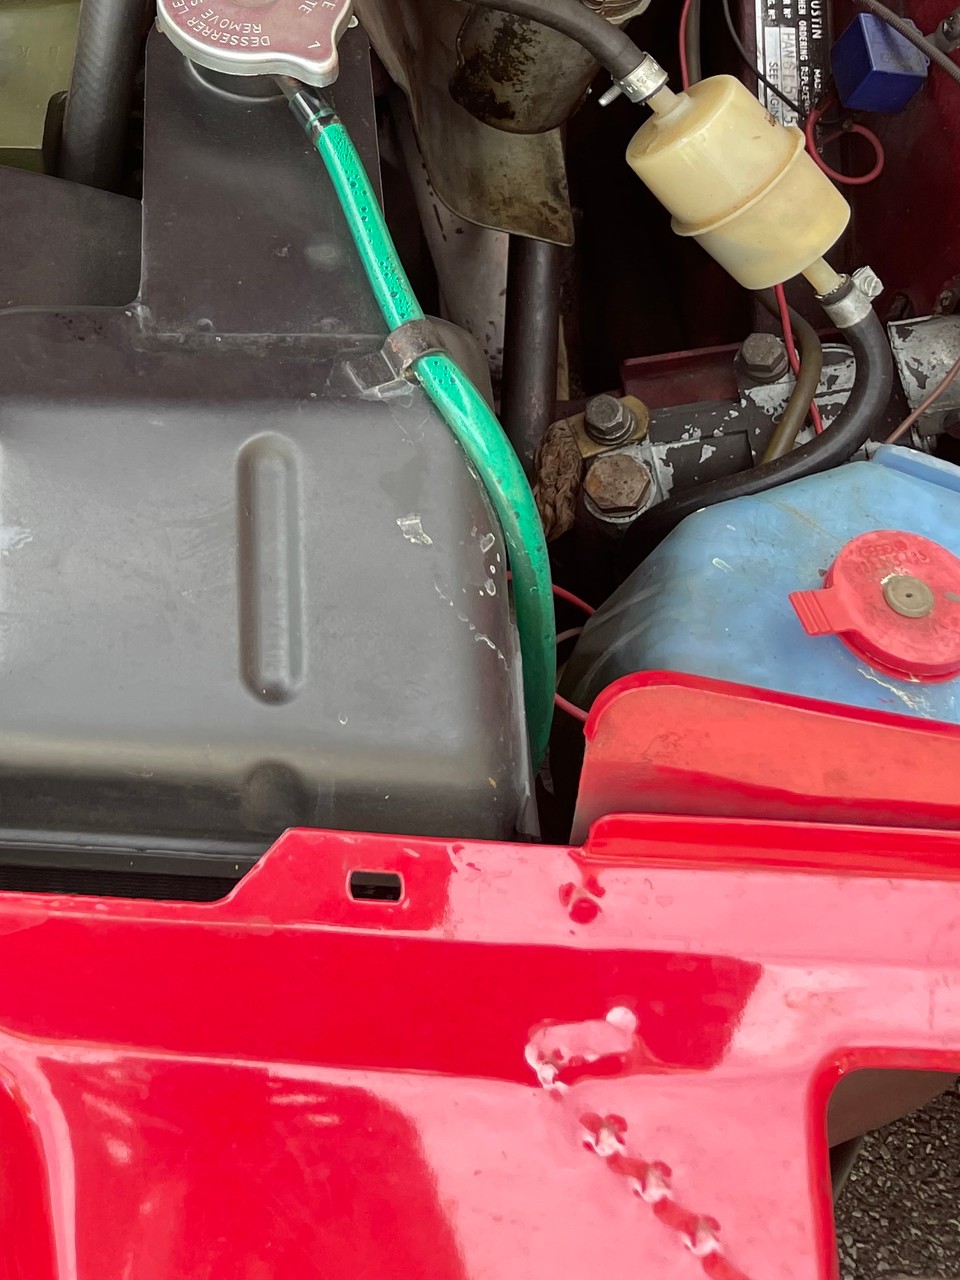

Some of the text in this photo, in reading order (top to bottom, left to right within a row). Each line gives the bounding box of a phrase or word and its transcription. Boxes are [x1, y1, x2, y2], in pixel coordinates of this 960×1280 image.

[186, 16, 271, 47] DESSERRER
[201, 8, 262, 34] REMOVE
[798, 20, 808, 61] ORDERING
[769, 61, 778, 80] SEE
